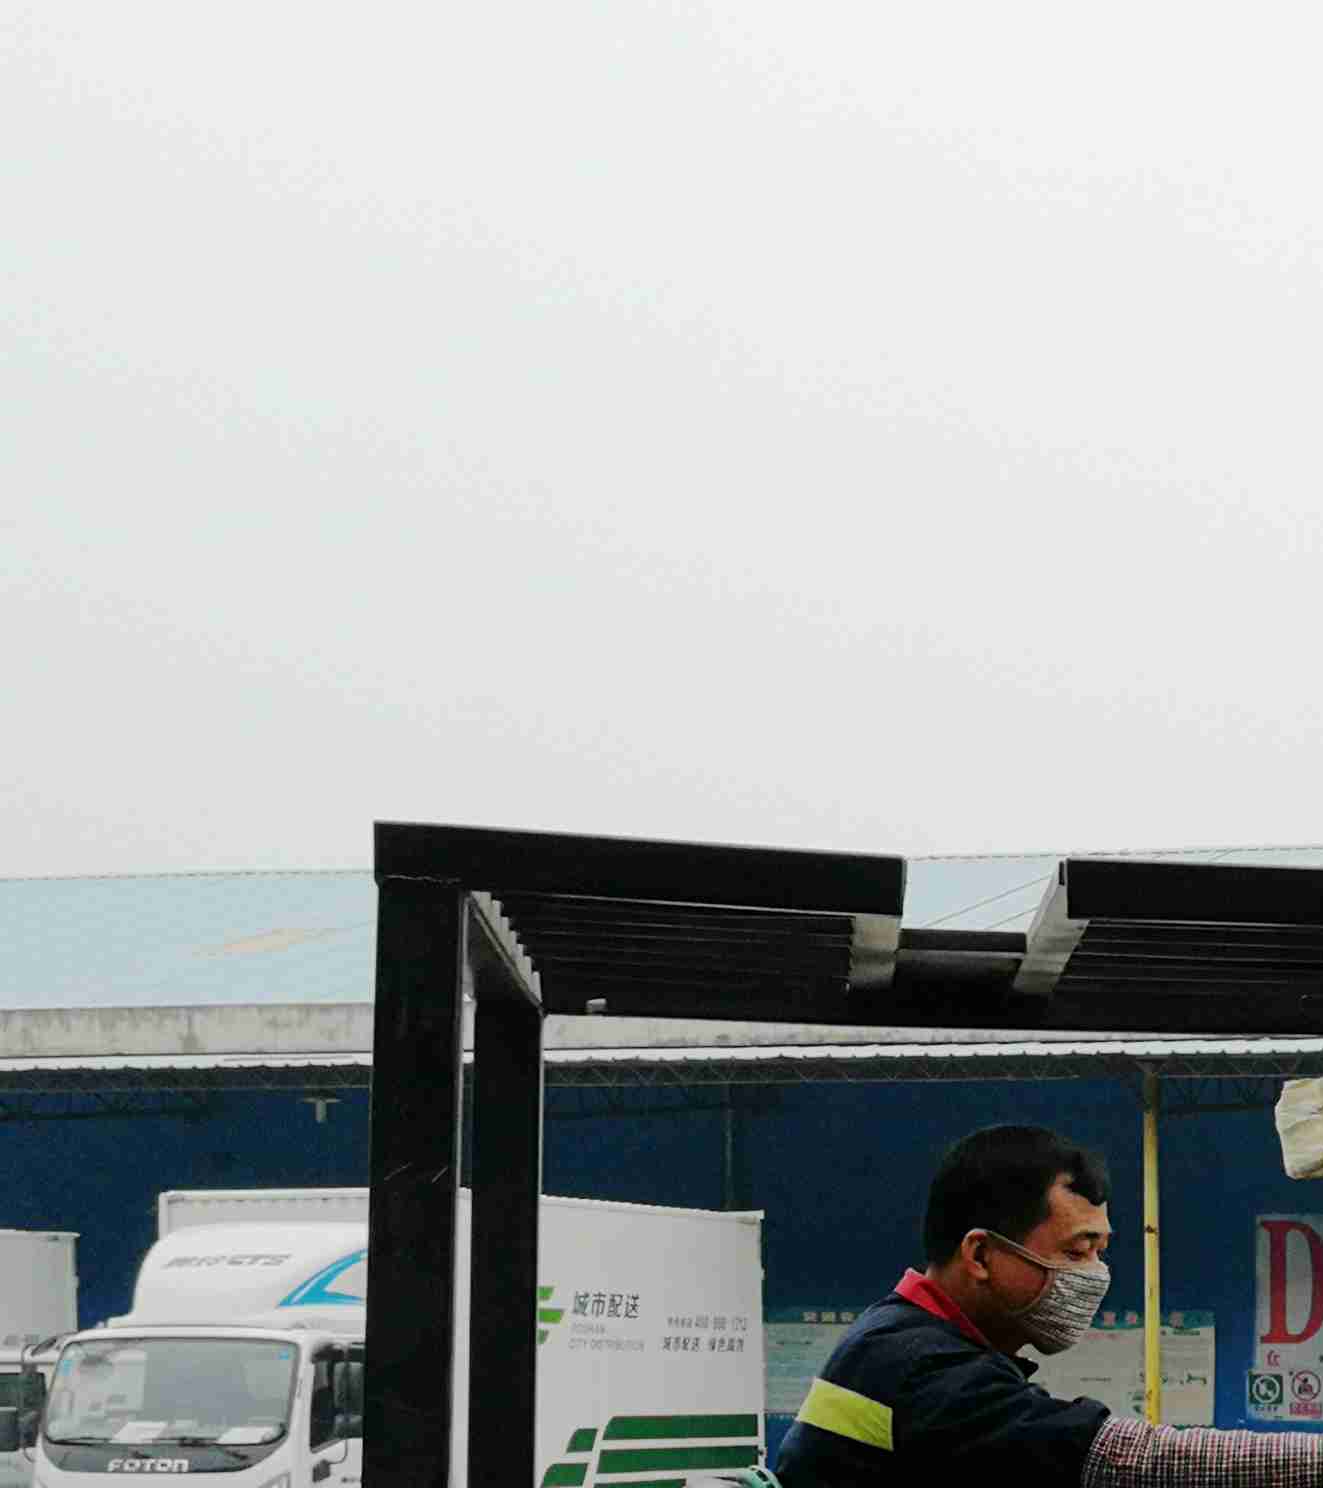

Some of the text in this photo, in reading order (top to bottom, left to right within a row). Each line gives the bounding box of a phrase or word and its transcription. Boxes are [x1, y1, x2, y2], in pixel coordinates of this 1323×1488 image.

[571, 1290, 641, 1320] 城市配送
[107, 1457, 189, 1473] FOTON
